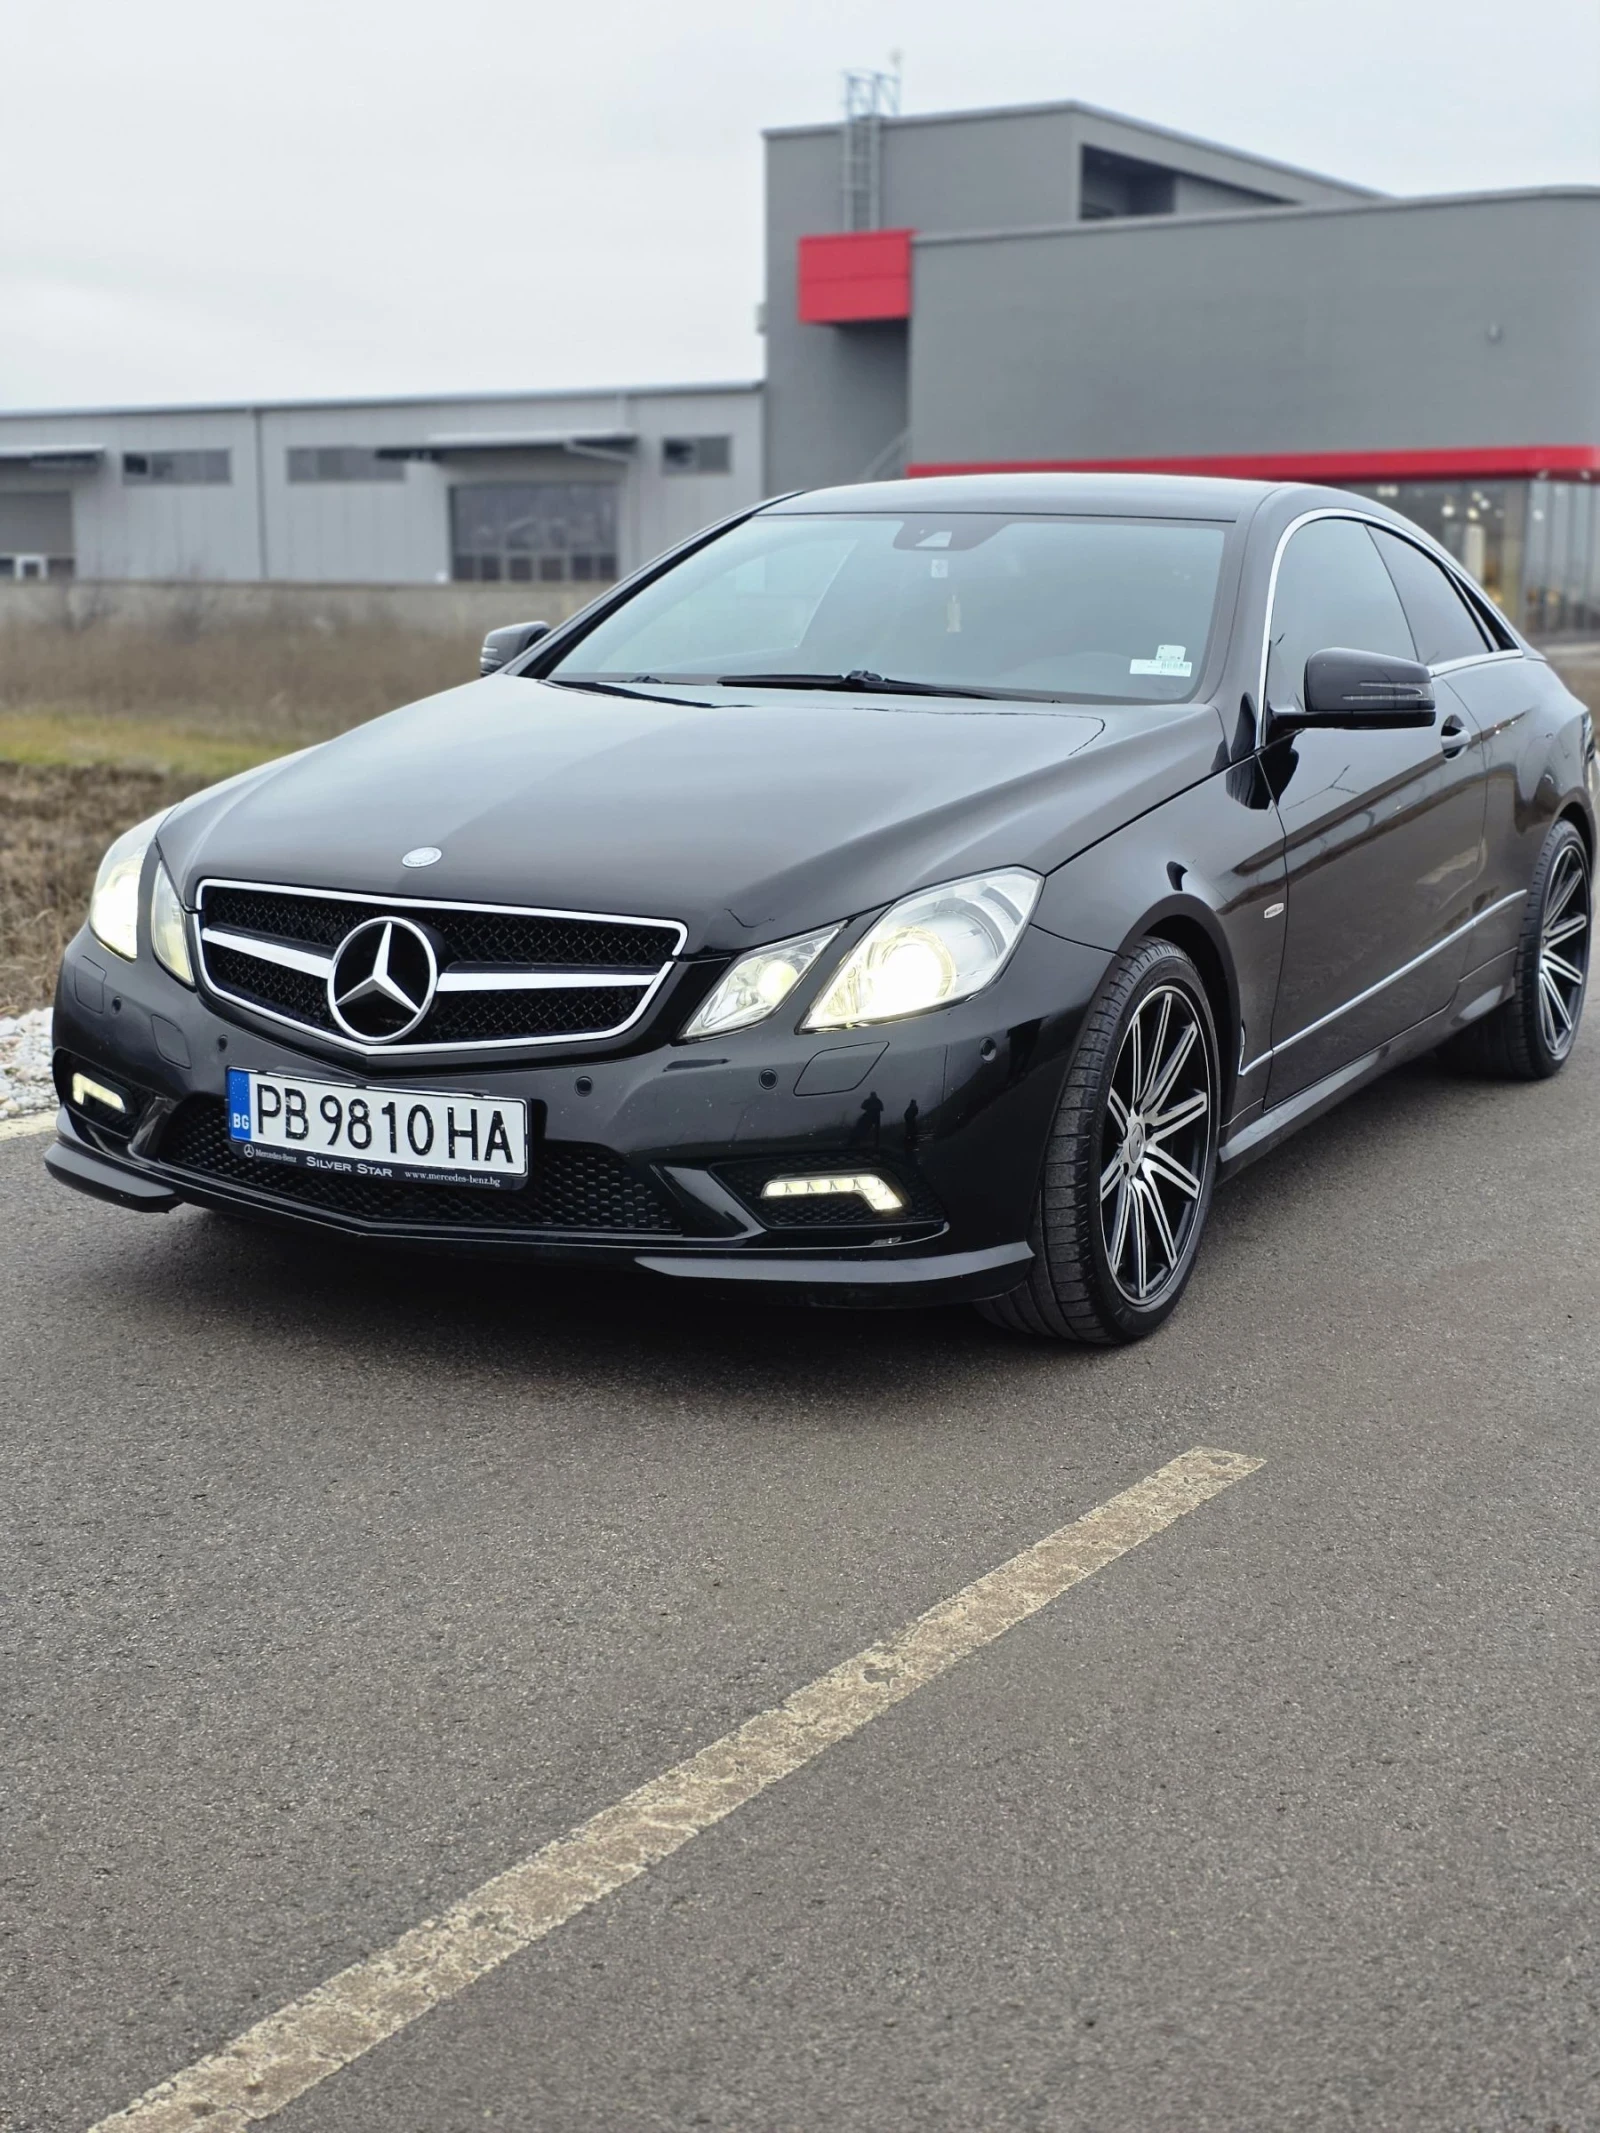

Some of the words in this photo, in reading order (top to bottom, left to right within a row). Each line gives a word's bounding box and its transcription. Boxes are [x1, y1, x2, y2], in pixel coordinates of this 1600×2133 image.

[233, 1113, 250, 1130] BG
[256, 1083, 309, 1140] PB
[319, 1095, 435, 1156] 9810
[447, 1106, 514, 1163] HA
[255, 1149, 297, 1163] Mercedes-Benz
[306, 1156, 352, 1172] SILVER
[357, 1163, 393, 1177] STAR
[404, 1171, 500, 1187] www.mercedes-benz.bg
